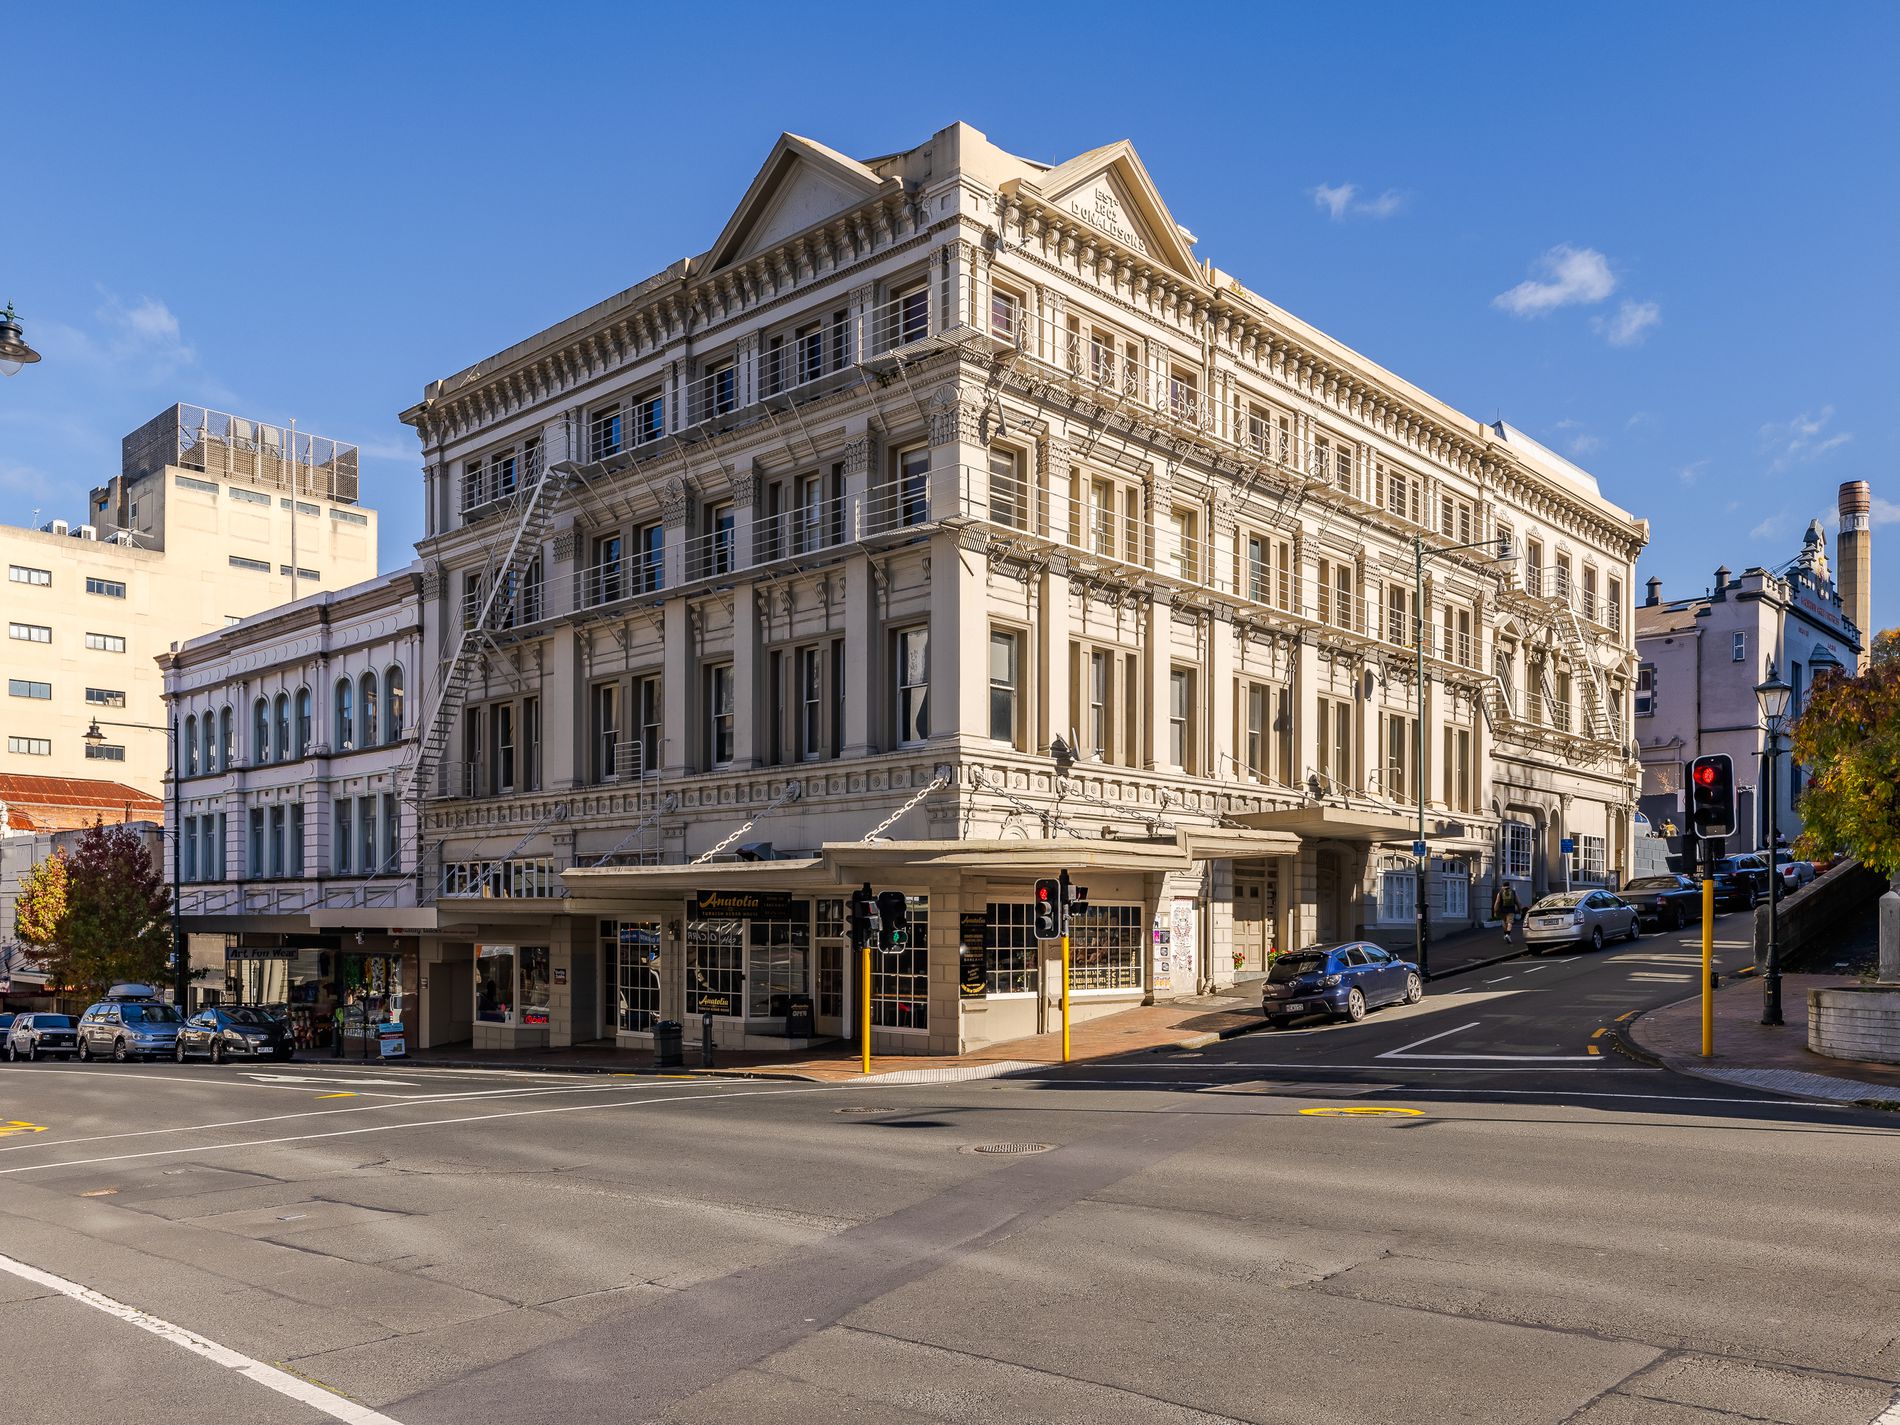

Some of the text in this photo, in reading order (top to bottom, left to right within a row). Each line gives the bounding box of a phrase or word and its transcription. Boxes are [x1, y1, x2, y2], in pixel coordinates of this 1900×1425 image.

[1071, 200, 1145, 252] DONALDSONS
[700, 892, 759, 908] Anatolia
[230, 949, 249, 958] Art
[272, 948, 297, 958] Wear
